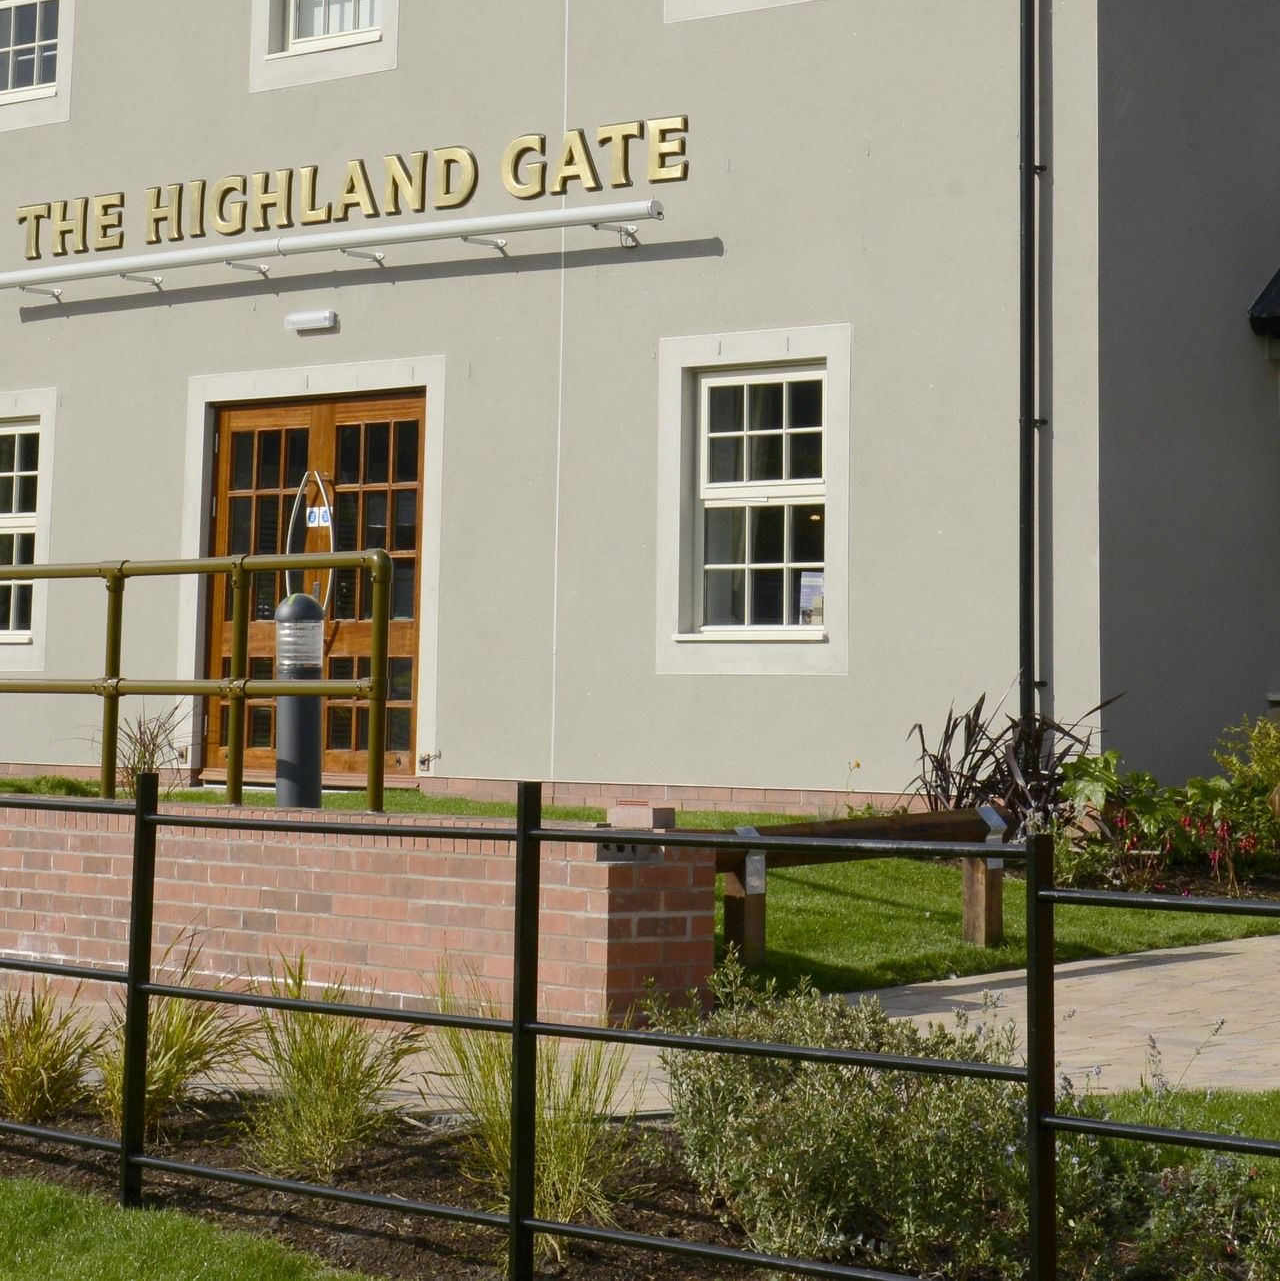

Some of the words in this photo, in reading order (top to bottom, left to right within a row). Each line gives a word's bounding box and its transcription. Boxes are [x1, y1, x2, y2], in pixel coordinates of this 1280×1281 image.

[17, 191, 124, 259] THE
[145, 146, 479, 243] HIGHLAND
[501, 114, 689, 199] GATE
